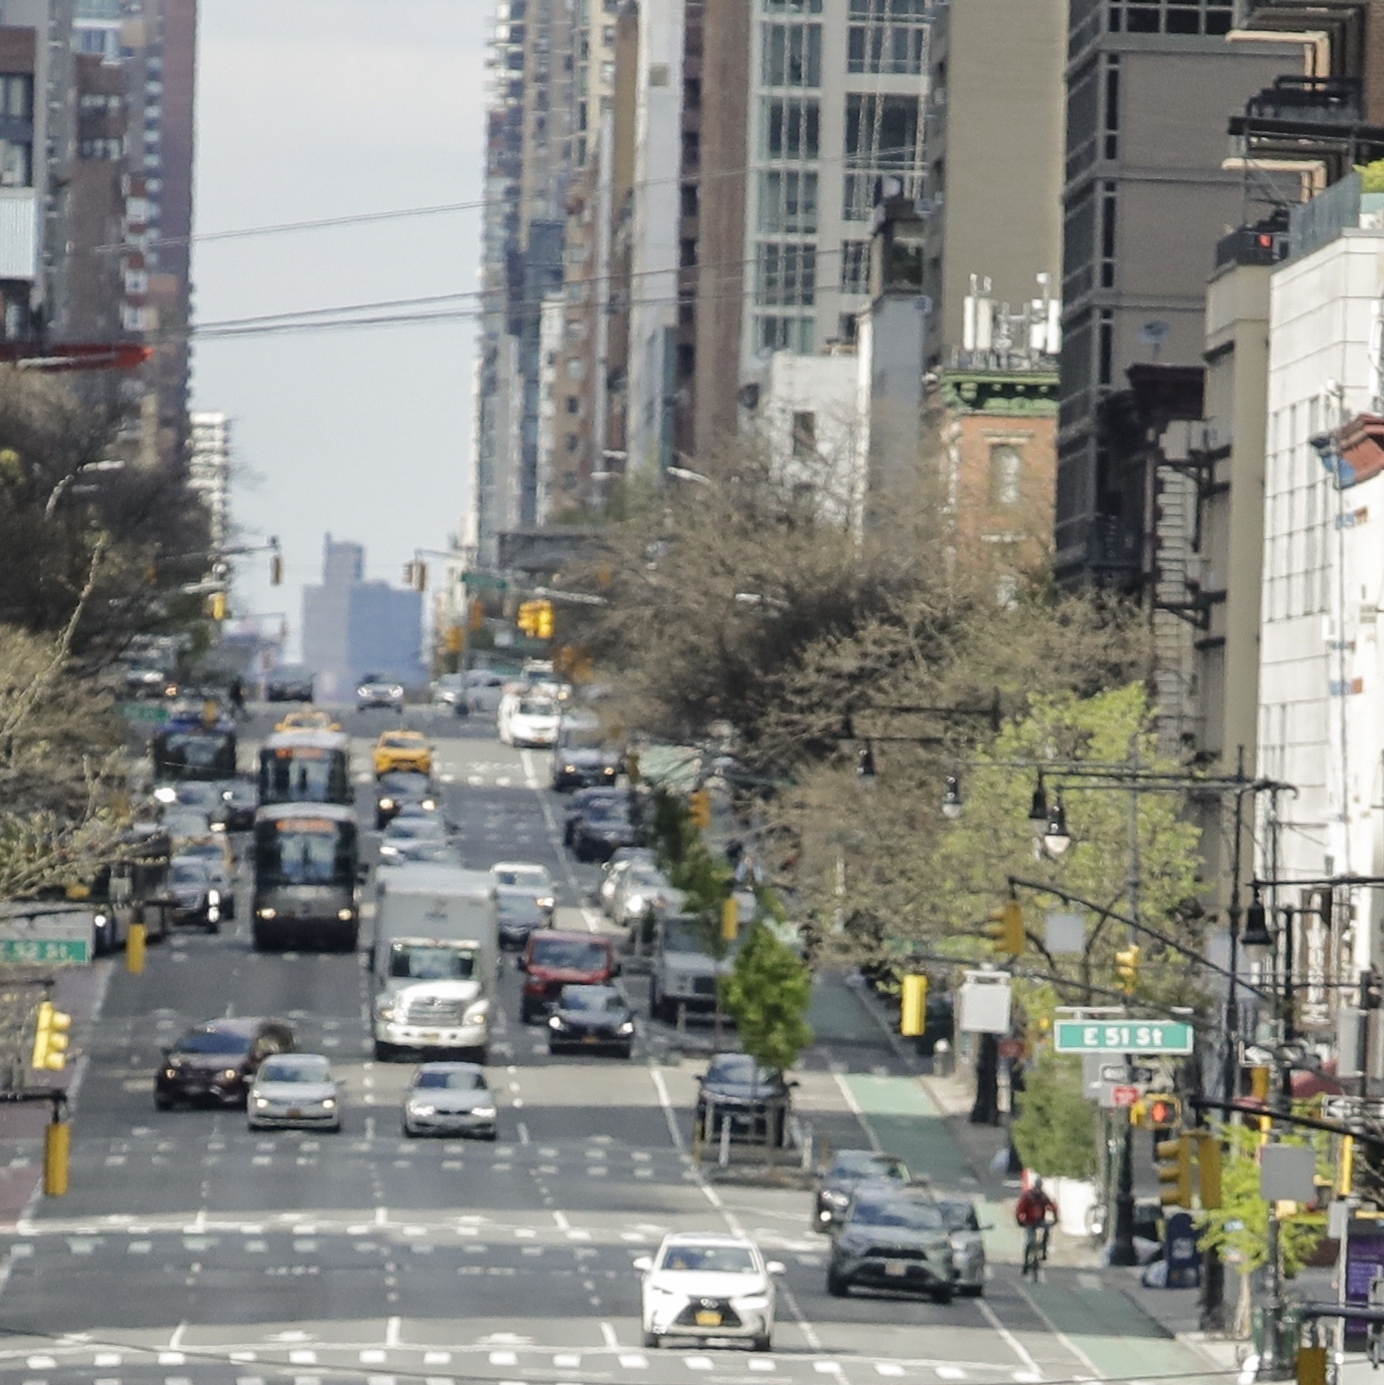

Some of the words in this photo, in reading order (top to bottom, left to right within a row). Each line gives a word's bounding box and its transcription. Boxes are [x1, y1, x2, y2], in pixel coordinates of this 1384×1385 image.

[1083, 1027, 1099, 1046] E
[1105, 1027, 1130, 1046] 51
[1136, 1027, 1163, 1046] St
